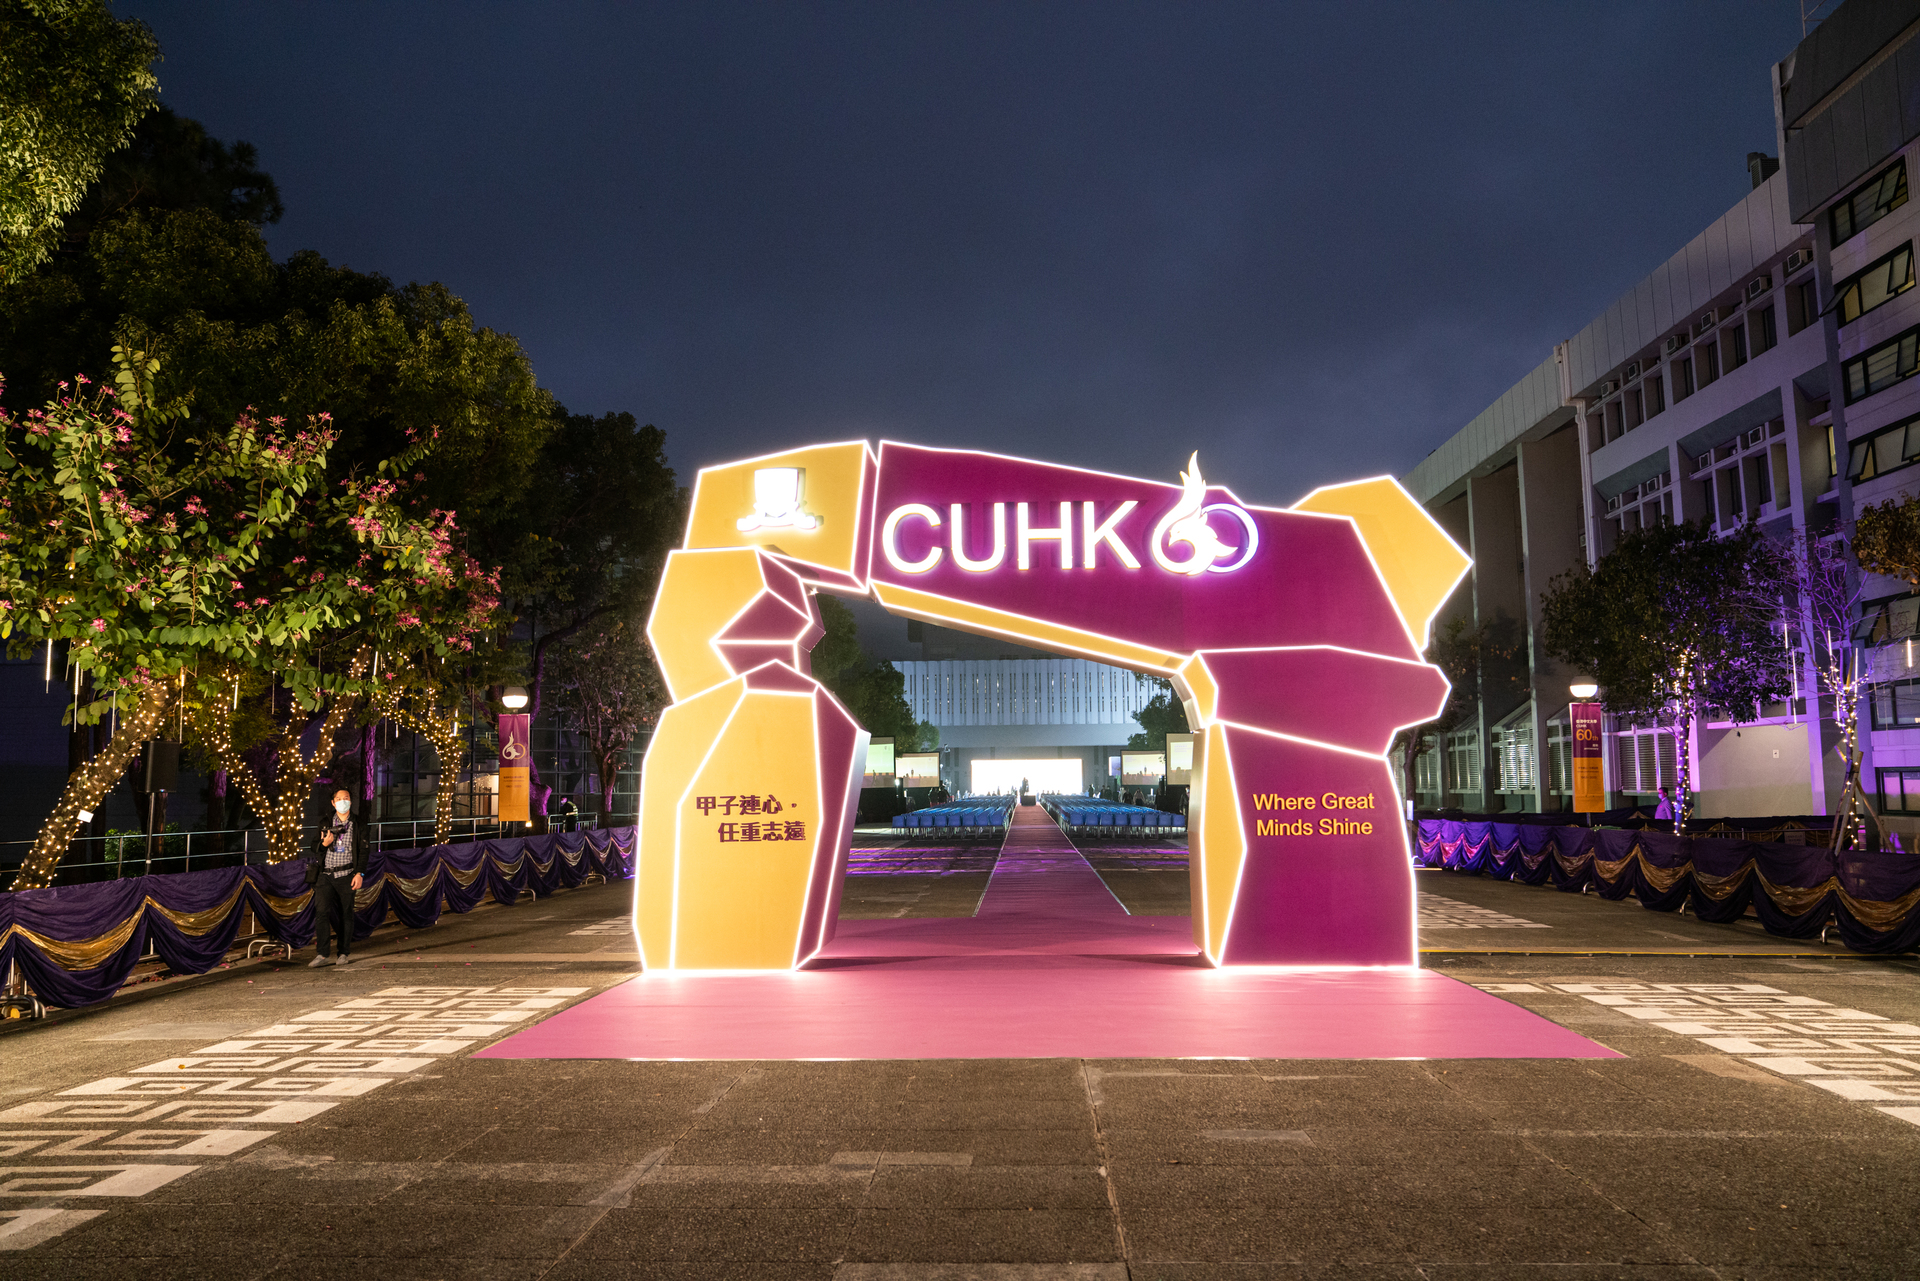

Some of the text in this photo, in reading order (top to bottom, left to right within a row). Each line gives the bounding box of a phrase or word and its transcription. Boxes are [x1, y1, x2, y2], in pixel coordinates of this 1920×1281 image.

[882, 500, 1141, 574] CUHK
[1576, 729, 1599, 741] 60th
[1252, 792, 1375, 810] Where Great
[717, 821, 806, 842] 任重志遠
[1256, 818, 1373, 836] Minds Shine
